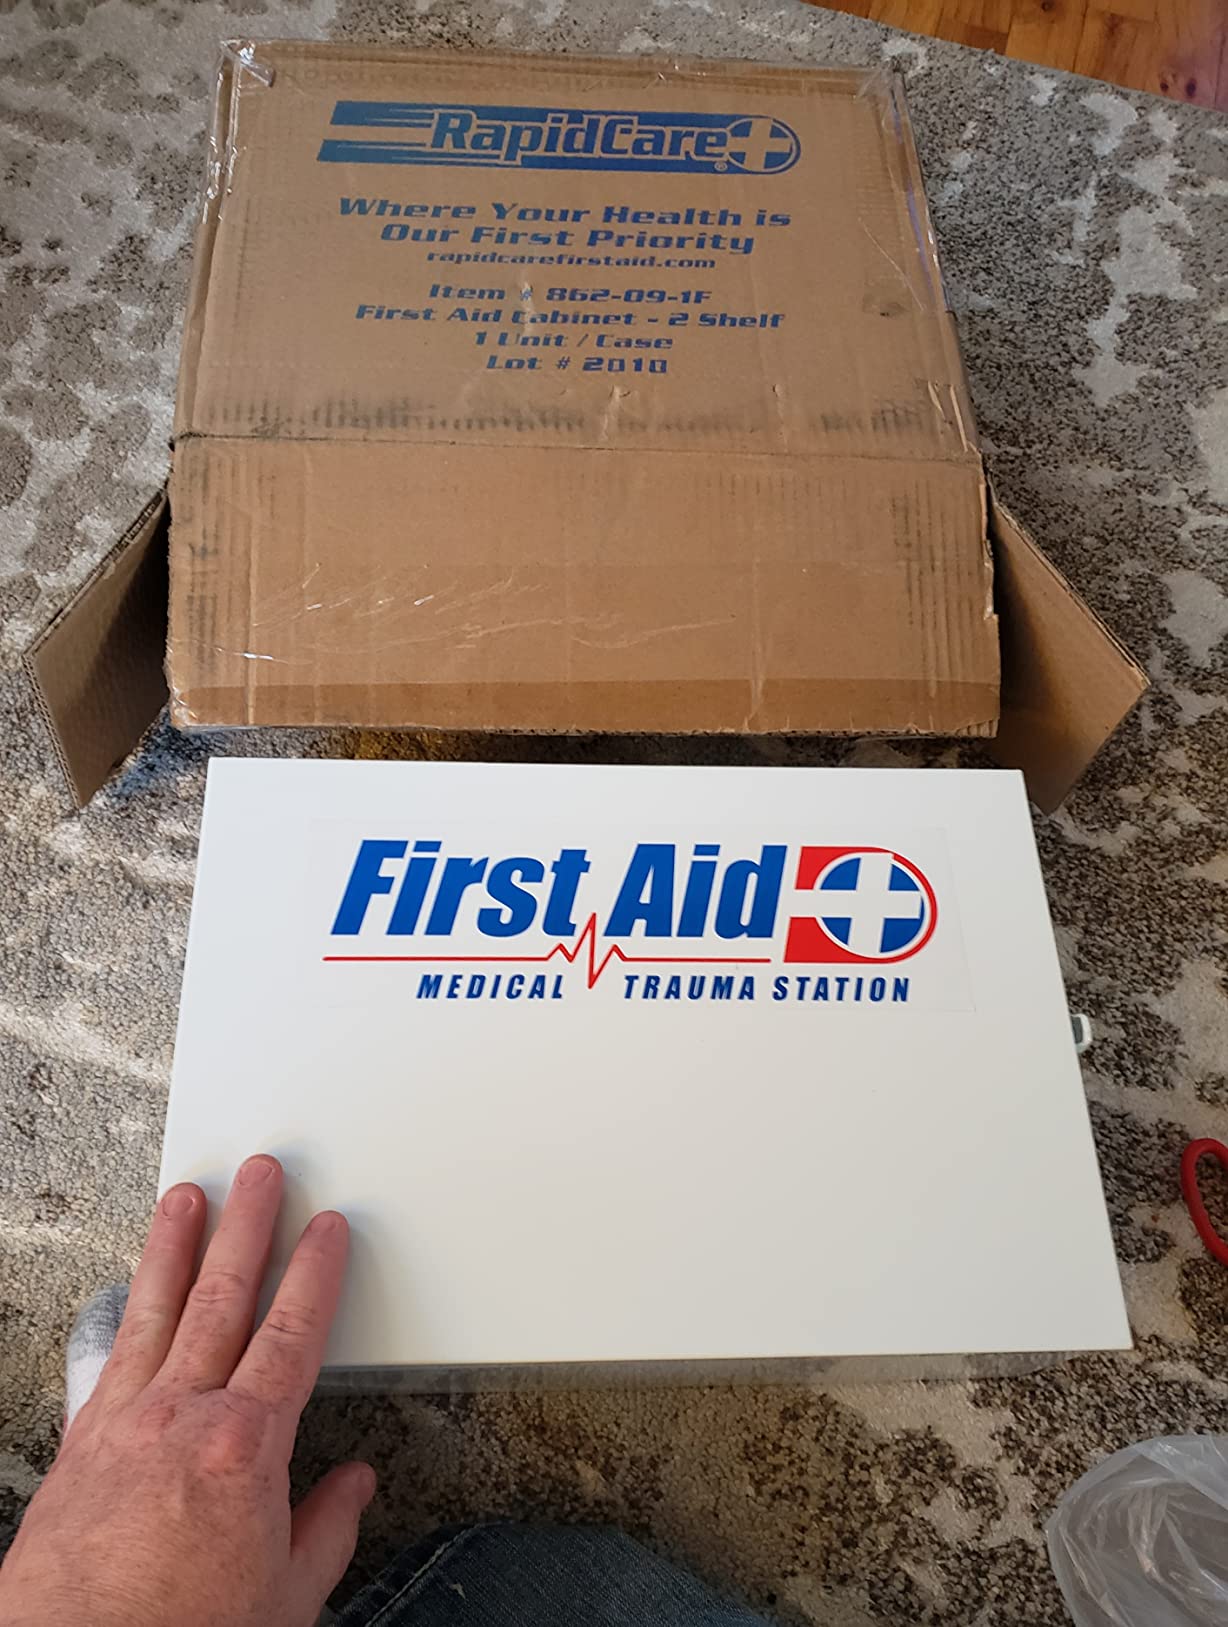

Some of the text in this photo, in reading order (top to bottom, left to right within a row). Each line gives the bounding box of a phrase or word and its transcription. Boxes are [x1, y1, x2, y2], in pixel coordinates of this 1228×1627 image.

[340, 198, 792, 227] Where Your Health is
[380, 225, 754, 255] Our First Priority
[427, 252, 717, 269] rapidcarefirstaid.com
[428, 284, 506, 301] Item
[546, 287, 713, 305] 862-09-1F
[355, 305, 439, 321] First
[447, 307, 501, 324] Aid
[511, 310, 638, 326] Cabinet
[668, 312, 690, 327] 2
[697, 313, 785, 329] Shelf
[475, 331, 674, 350] 1 Unit / Case
[486, 356, 543, 370] Lot
[582, 357, 668, 374] 2010
[330, 839, 788, 939] First Aid
[416, 974, 909, 1002] MEDICAL TRAUMA STATION
